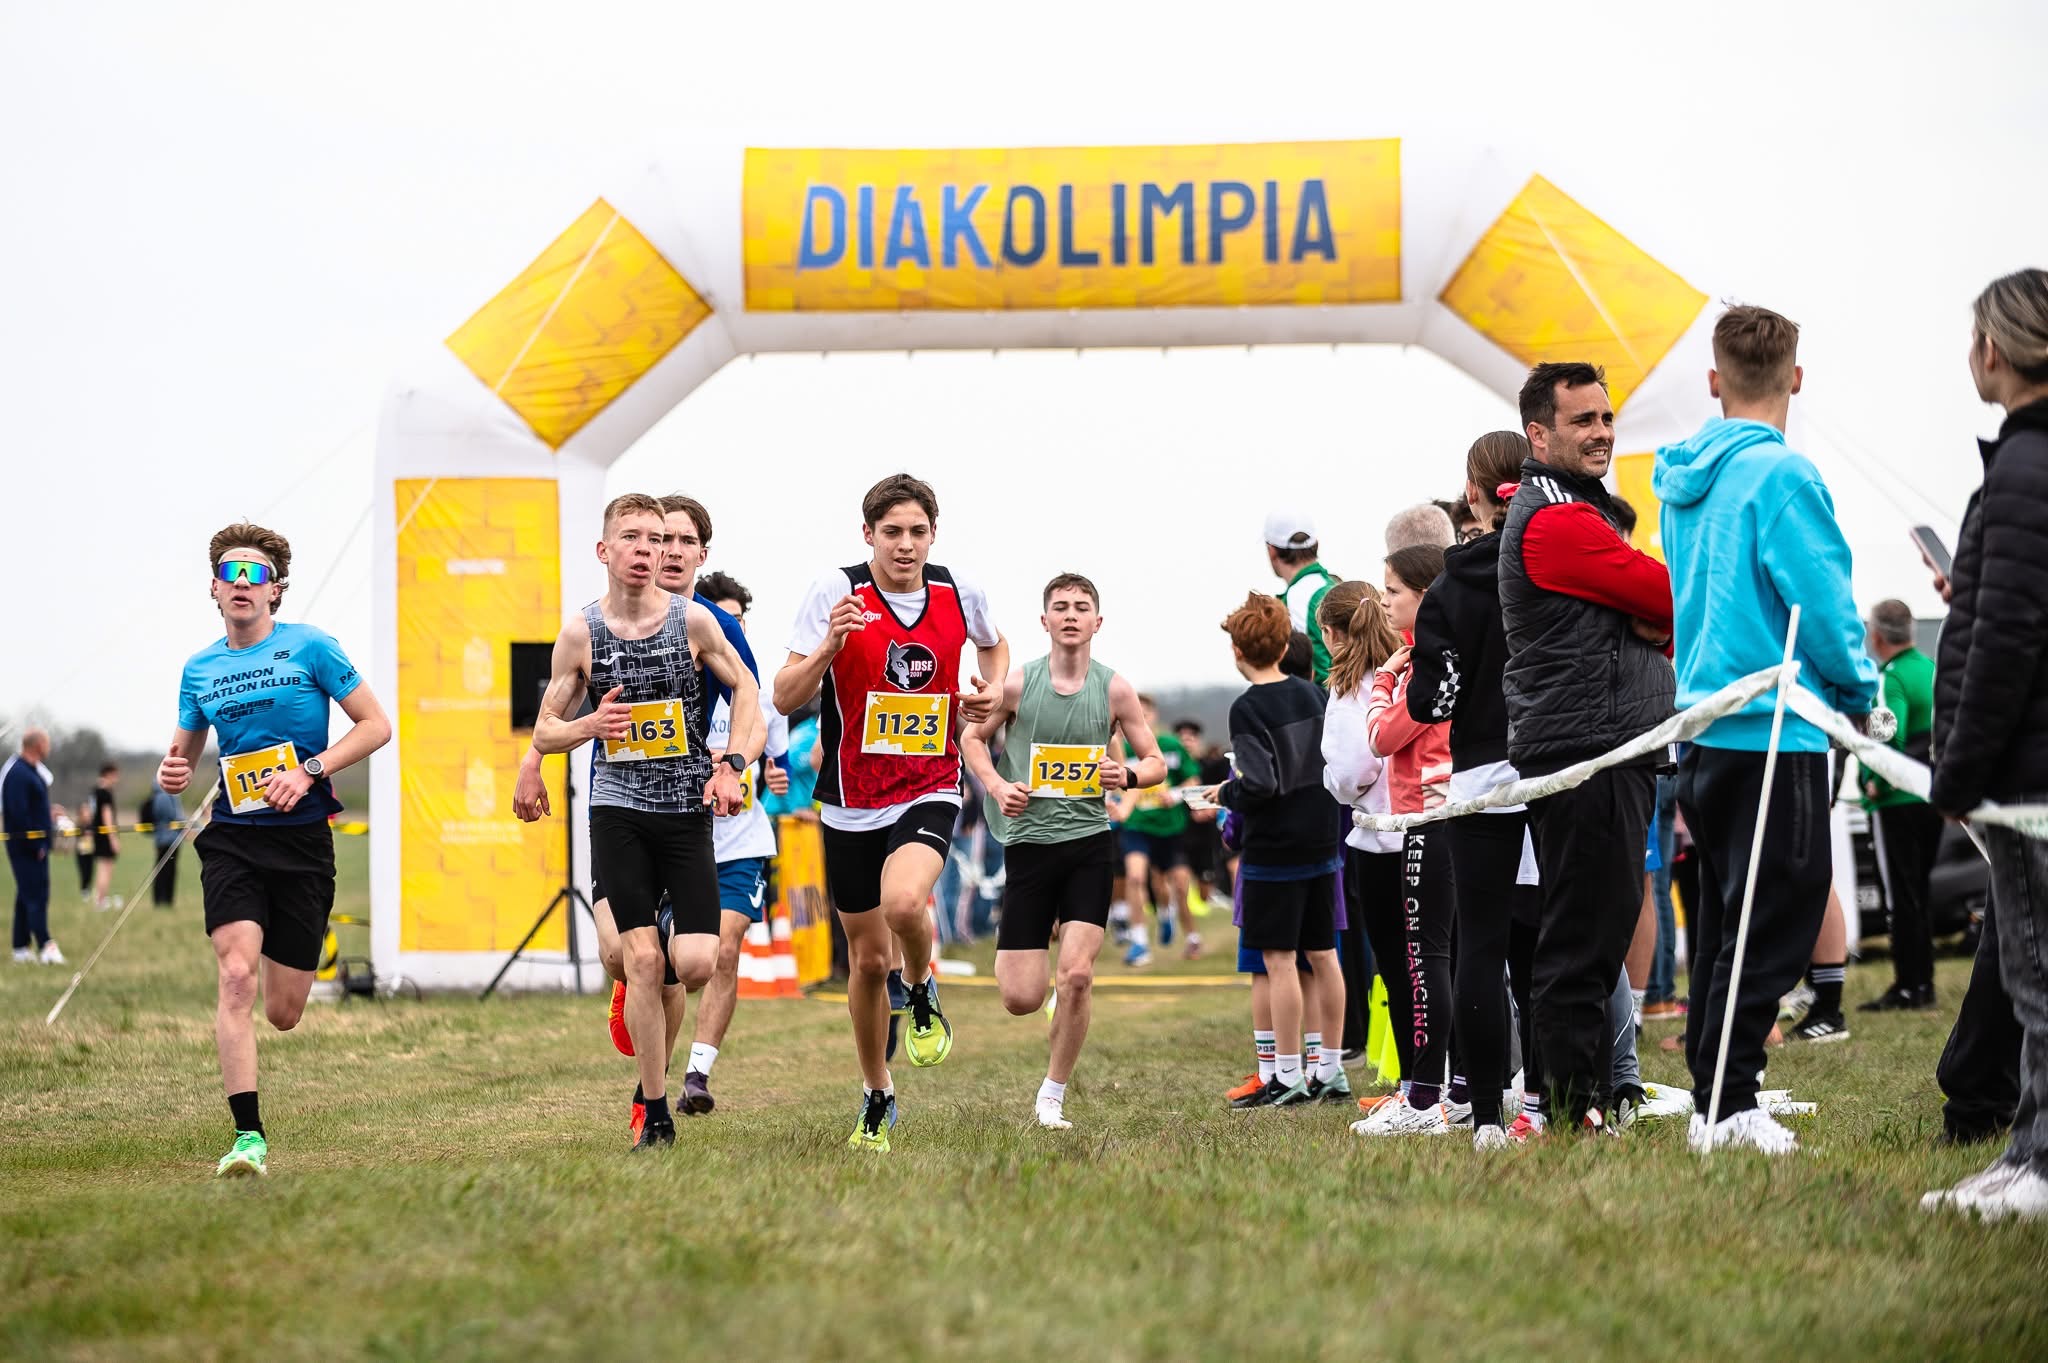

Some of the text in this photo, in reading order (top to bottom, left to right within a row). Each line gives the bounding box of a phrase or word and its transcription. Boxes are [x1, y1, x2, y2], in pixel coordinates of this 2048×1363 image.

[800, 180, 1338, 269] DIÁKOLIMPIA
[213, 666, 274, 688] PANNON
[910, 660, 933, 672] JDSE
[199, 676, 301, 705] TRIATLON KLUB
[619, 719, 677, 743] 163
[876, 713, 939, 736] 1123
[1038, 762, 1099, 782] 1257
[1404, 834, 1429, 1048] KEEP ON DANCING
